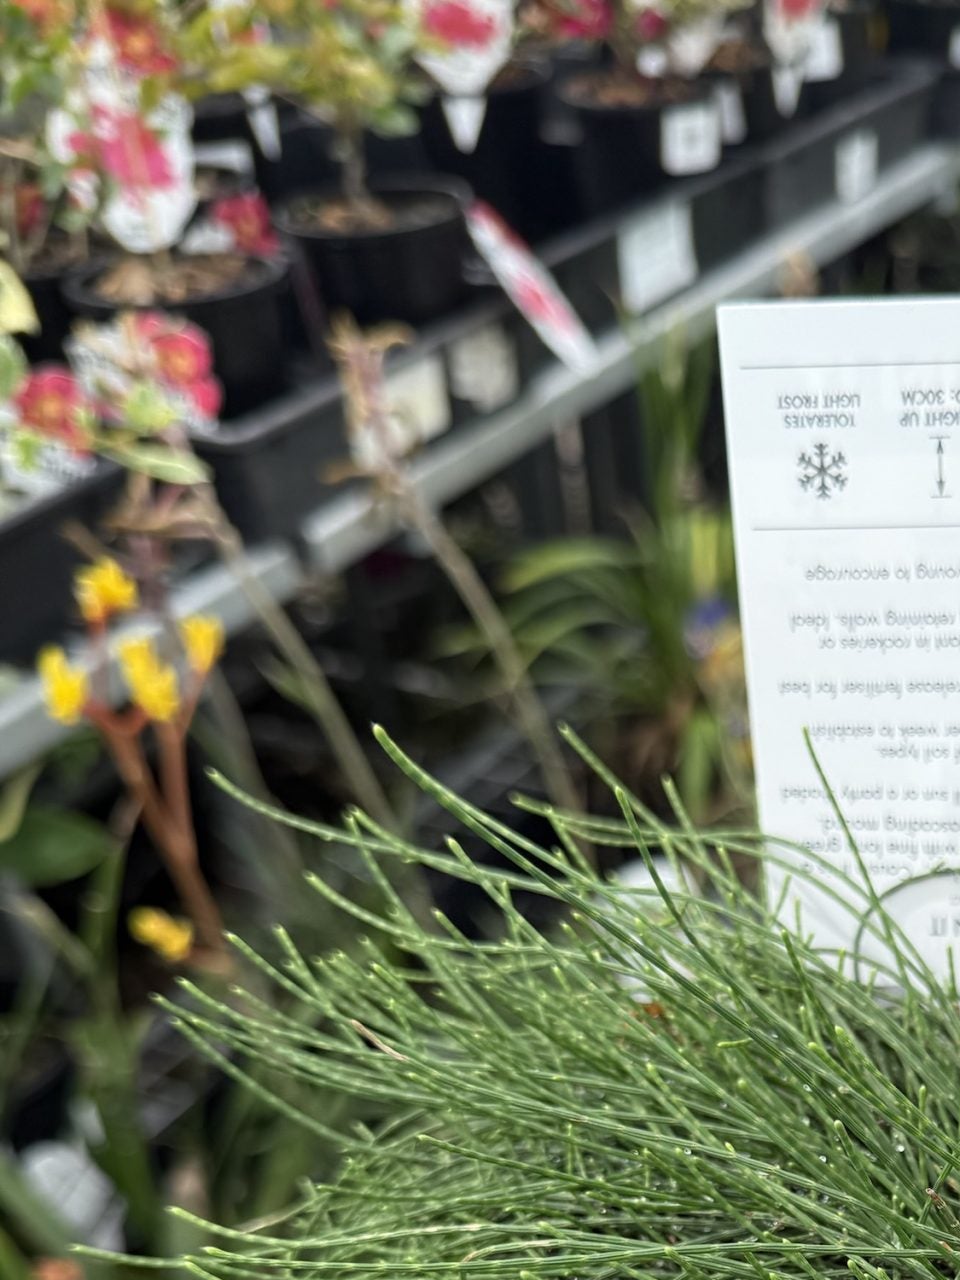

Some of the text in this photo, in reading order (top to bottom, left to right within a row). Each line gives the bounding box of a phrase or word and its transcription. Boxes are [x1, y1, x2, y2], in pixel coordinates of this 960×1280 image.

[776, 392, 861, 411] LIGHT FROST
[899, 389, 945, 407] 30CM
[783, 413, 857, 430] TOLERATES
[898, 411, 920, 428] UP
[804, 564, 891, 583] encourage
[894, 567, 911, 584] to
[790, 614, 829, 635] Ideal
[834, 614, 880, 634] walls.
[885, 610, 955, 630] retaining
[817, 638, 836, 651] or
[838, 637, 911, 656] rockeries
[915, 637, 932, 653] in
[778, 681, 812, 700] best
[816, 682, 838, 701] for
[842, 681, 903, 701] fertiliser
[898, 726, 944, 745] week
[876, 744, 920, 762] types.
[923, 748, 950, 765] soil
[842, 785, 884, 806] partly
[921, 790, 950, 803] sun
[887, 843, 918, 861] fine
[929, 916, 948, 938] IT
